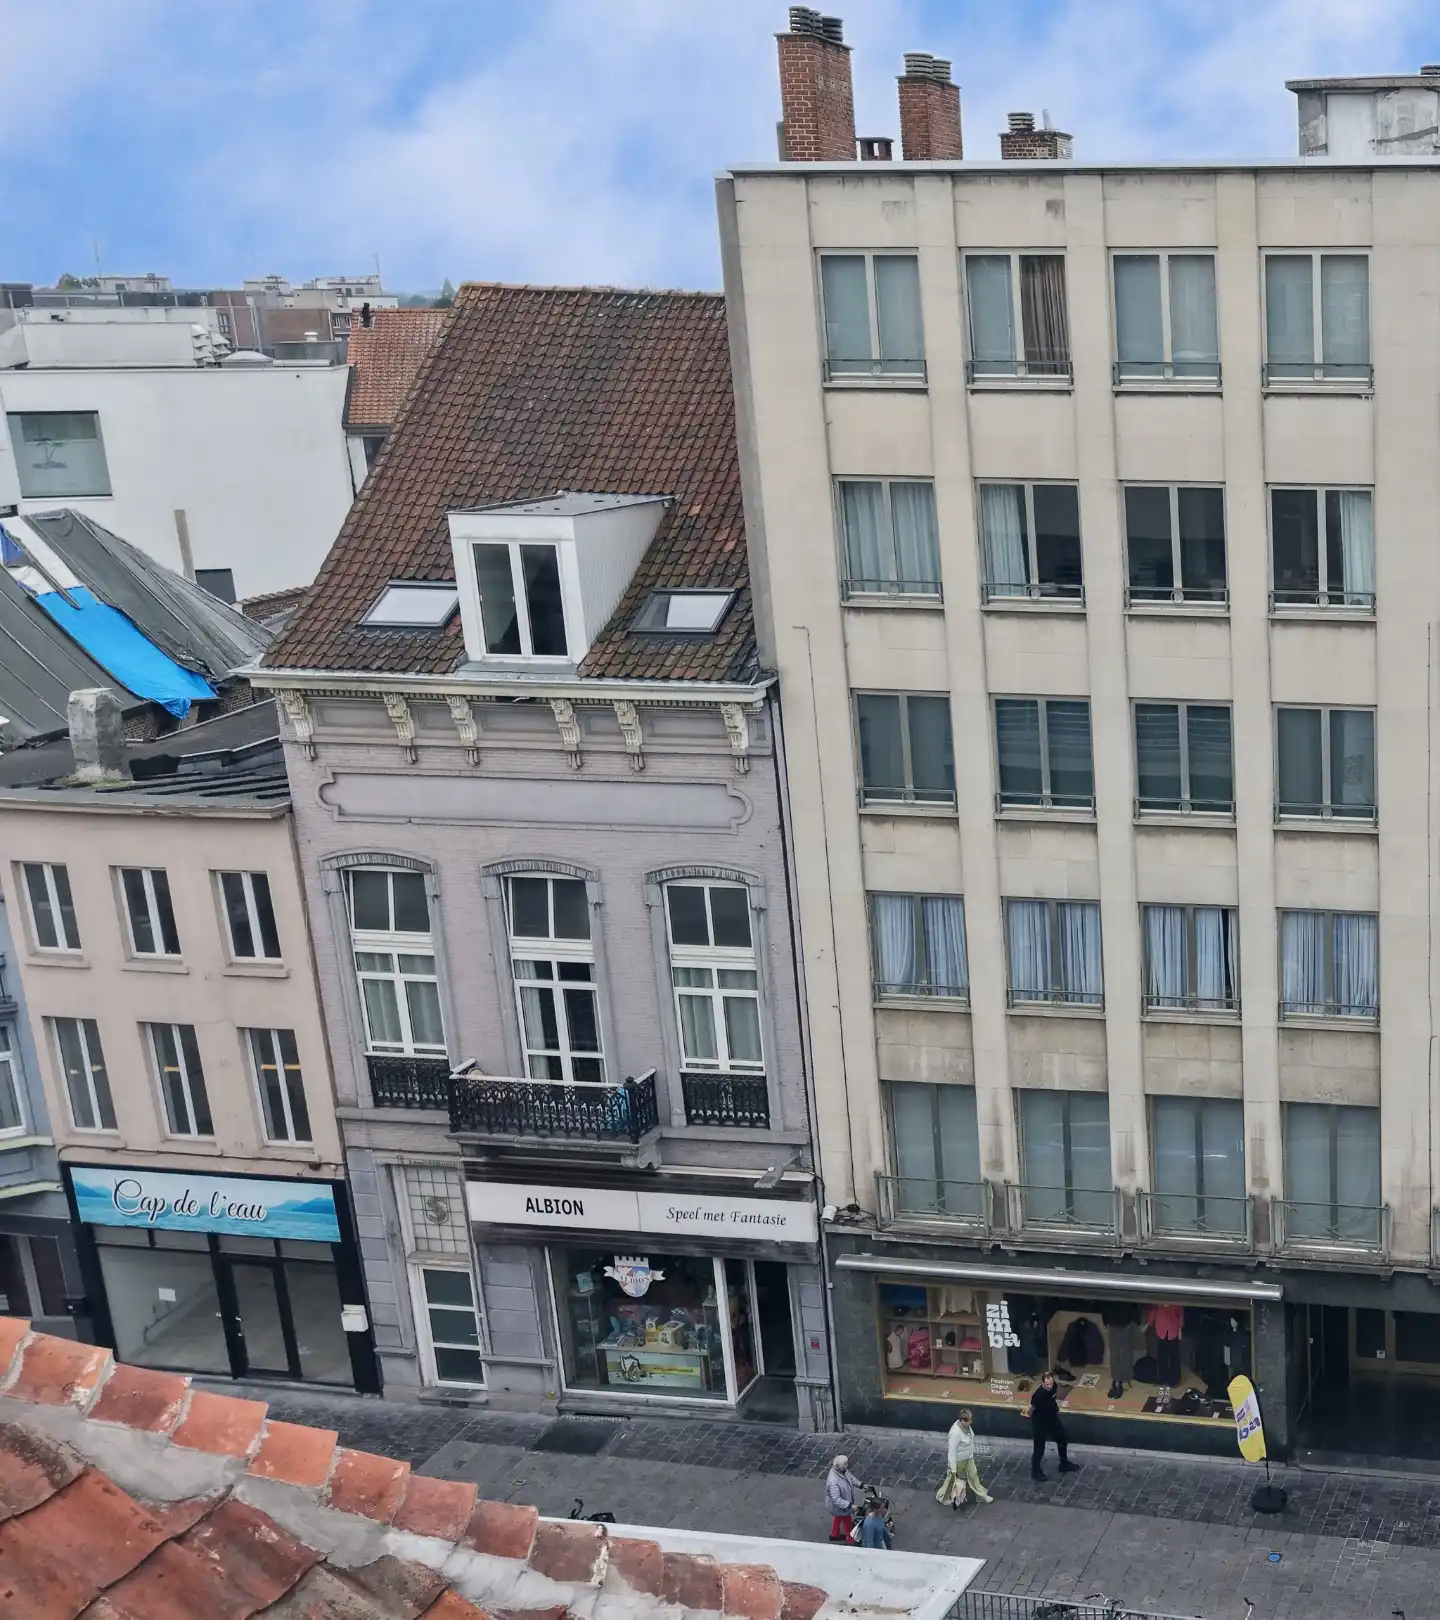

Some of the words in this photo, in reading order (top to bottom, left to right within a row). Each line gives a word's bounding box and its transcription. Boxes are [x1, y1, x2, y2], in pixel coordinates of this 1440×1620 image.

[113, 1177, 166, 1221] Cap
[173, 1188, 199, 1215] de
[210, 1191, 266, 1220] l'eau
[525, 1197, 584, 1216] ALBION
[666, 1206, 702, 1221] Speel
[703, 1210, 726, 1222] met
[730, 1211, 787, 1226] Fantasie
